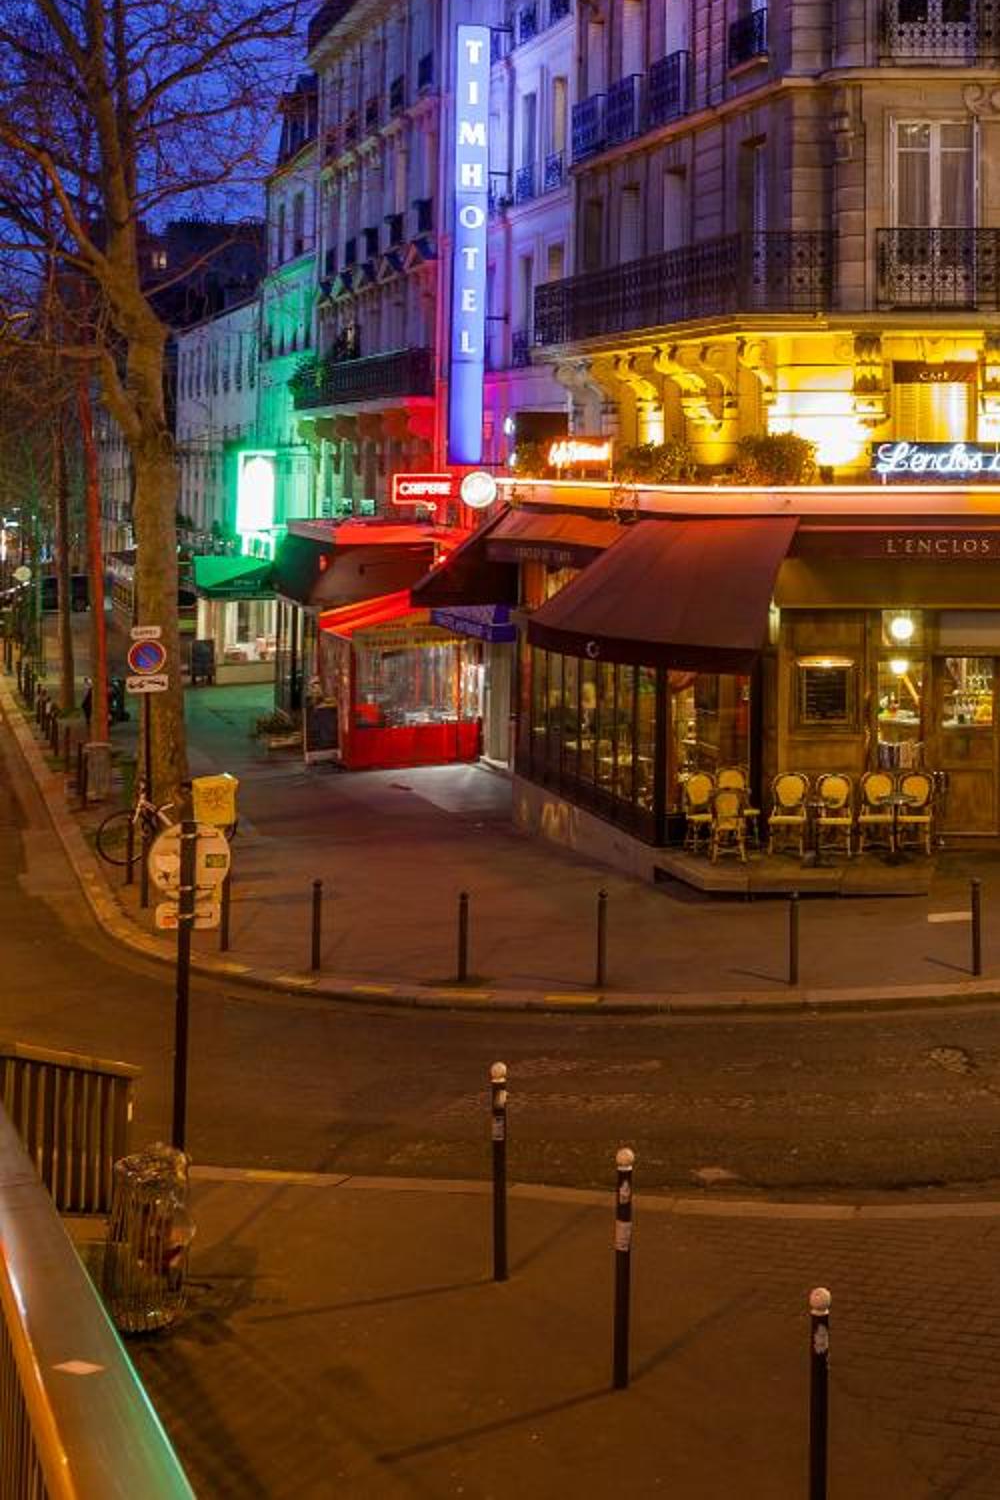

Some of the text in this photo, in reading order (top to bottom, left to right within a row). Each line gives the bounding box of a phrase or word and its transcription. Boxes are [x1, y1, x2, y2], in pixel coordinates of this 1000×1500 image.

[459, 40, 487, 353] TIMHOTEL
[876, 443, 983, 474] L'enclos
[887, 539, 991, 553] L'ENCLOS
